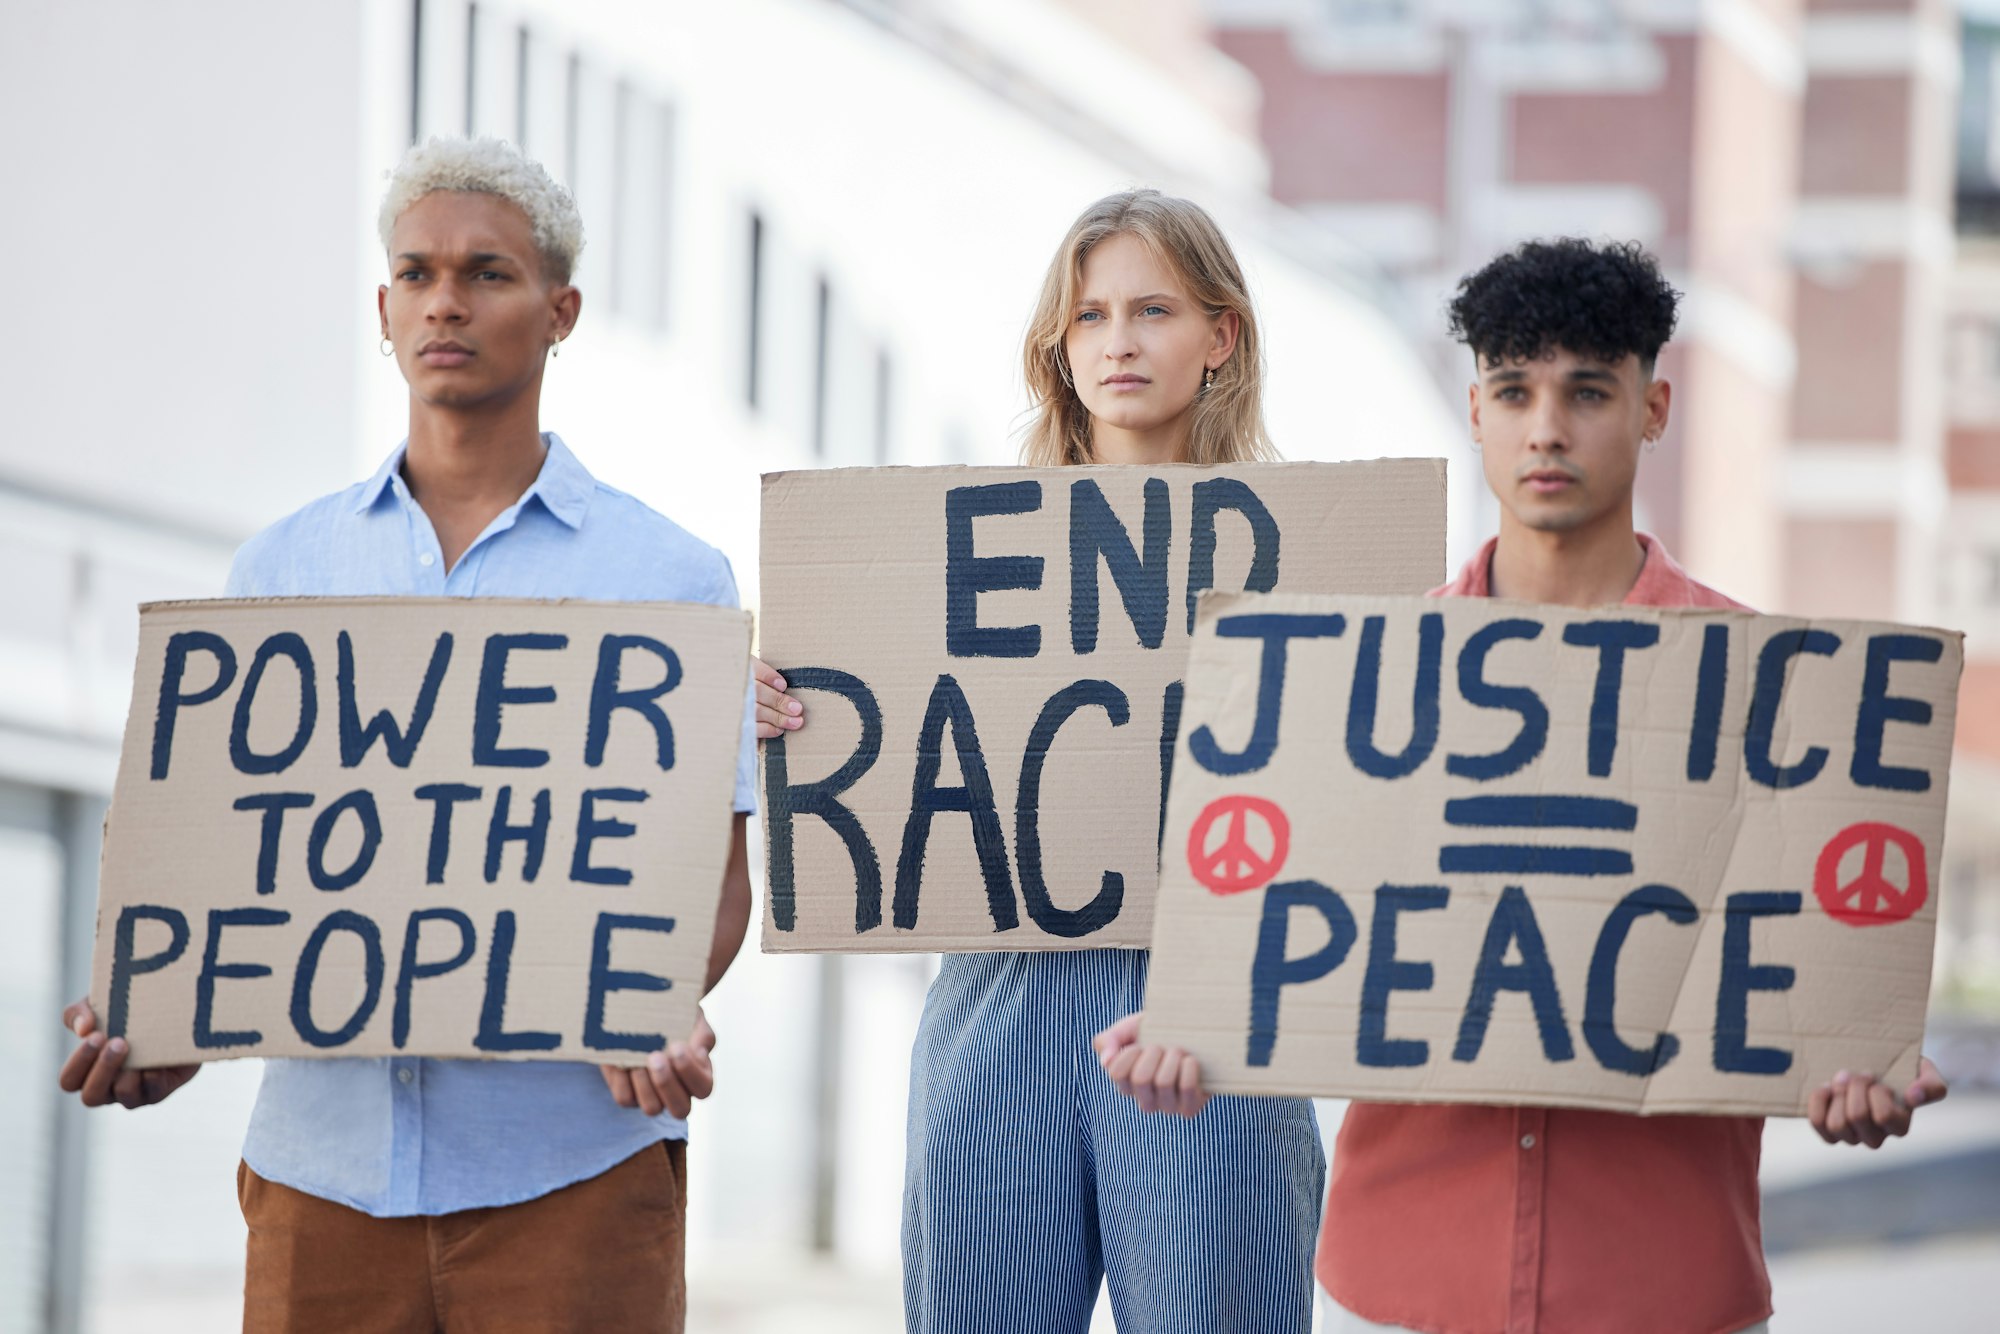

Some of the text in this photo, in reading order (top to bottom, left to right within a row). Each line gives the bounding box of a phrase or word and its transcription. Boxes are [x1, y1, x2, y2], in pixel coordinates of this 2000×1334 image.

[945, 477, 1281, 659] END
[149, 630, 684, 781] POWER
[1187, 612, 1946, 795] JUSTICE
[232, 783, 651, 896] TO THE
[762, 665, 1186, 939] RAC
[106, 904, 677, 1055] PEOPLE
[1246, 879, 1804, 1078] PEACE
